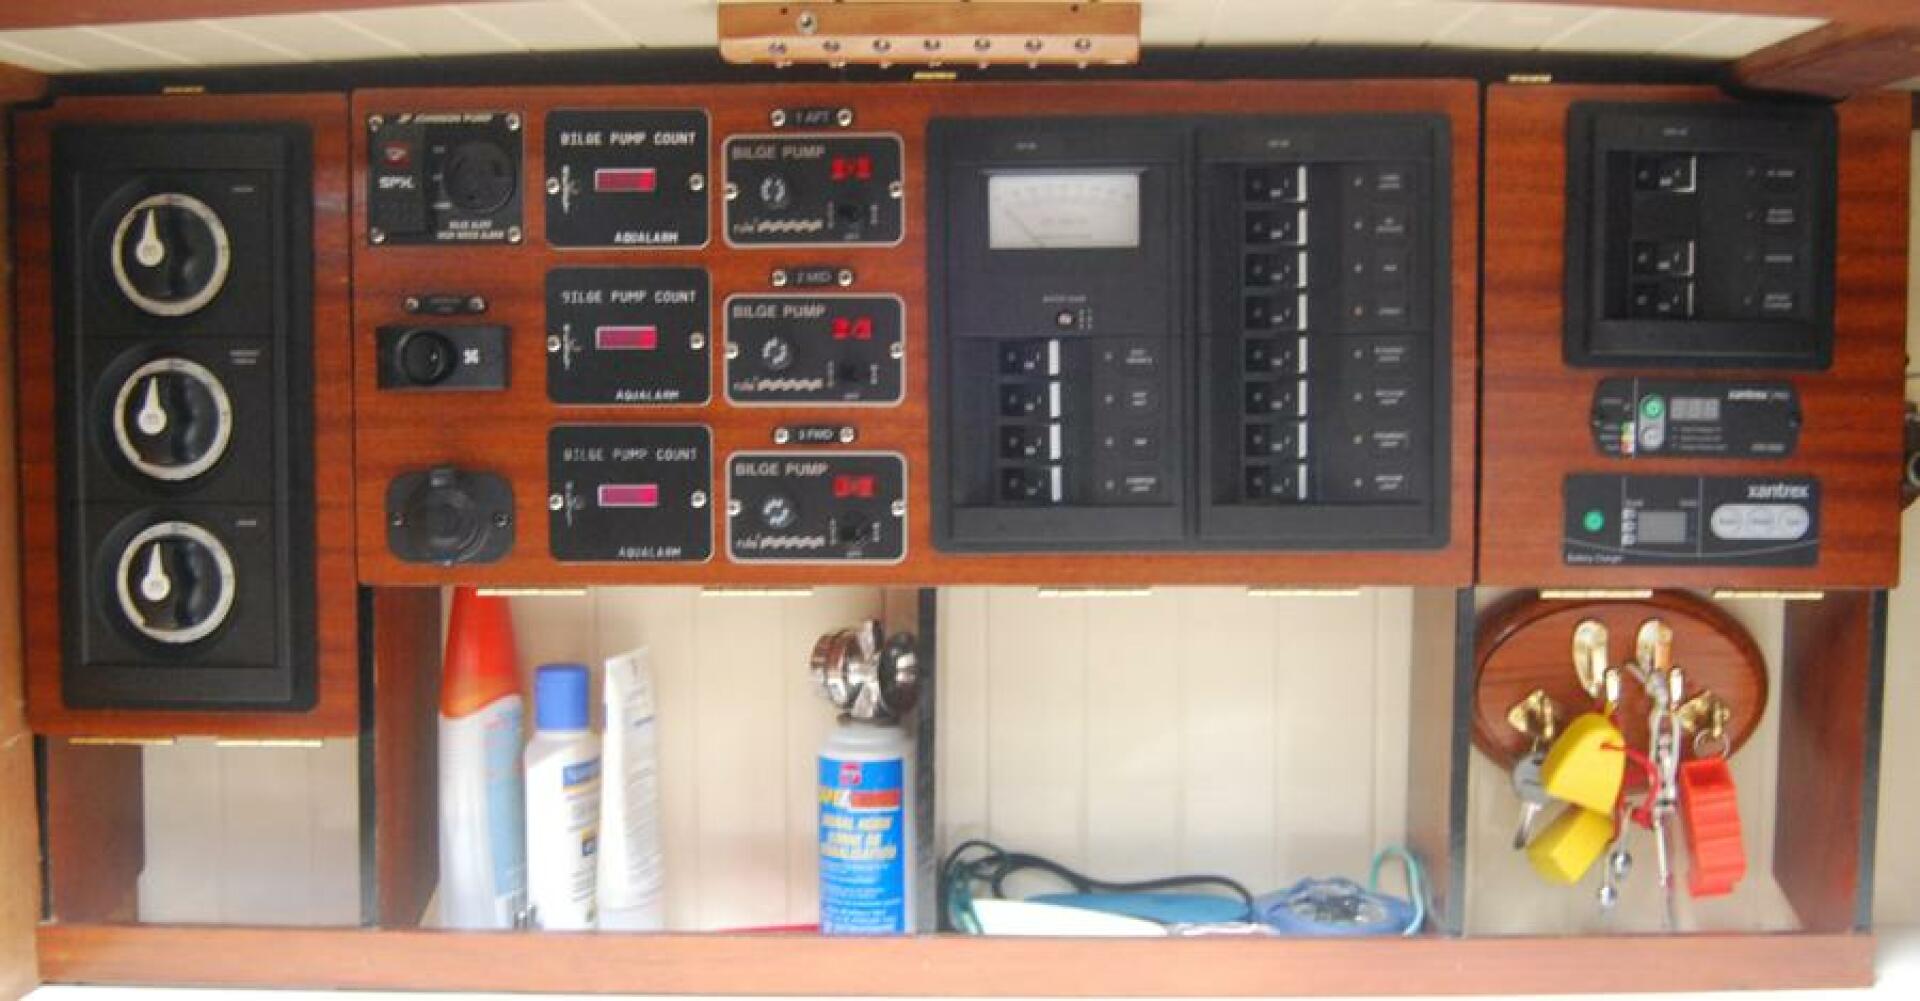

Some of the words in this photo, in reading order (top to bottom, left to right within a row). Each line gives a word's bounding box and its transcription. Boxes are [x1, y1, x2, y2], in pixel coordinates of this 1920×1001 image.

[560, 131, 602, 146] BILGE
[609, 131, 646, 145] PUMP
[654, 131, 696, 146] COUNT
[733, 145, 777, 160] BILGE
[782, 145, 825, 160] PUMP
[614, 231, 679, 244] AQUALARM
[610, 290, 647, 304] PUMP
[654, 290, 696, 304] COUNT
[733, 304, 777, 318] BILGE
[783, 304, 826, 318] PUMP
[615, 389, 680, 401] AQUALARM
[563, 447, 603, 462] BILGE
[613, 447, 648, 461] PUMP
[655, 447, 697, 462] COUNT
[735, 463, 780, 477] BILGE
[785, 463, 828, 477] PUMP
[1747, 484, 1810, 498] xantrex
[618, 545, 681, 558] AQUALARM
